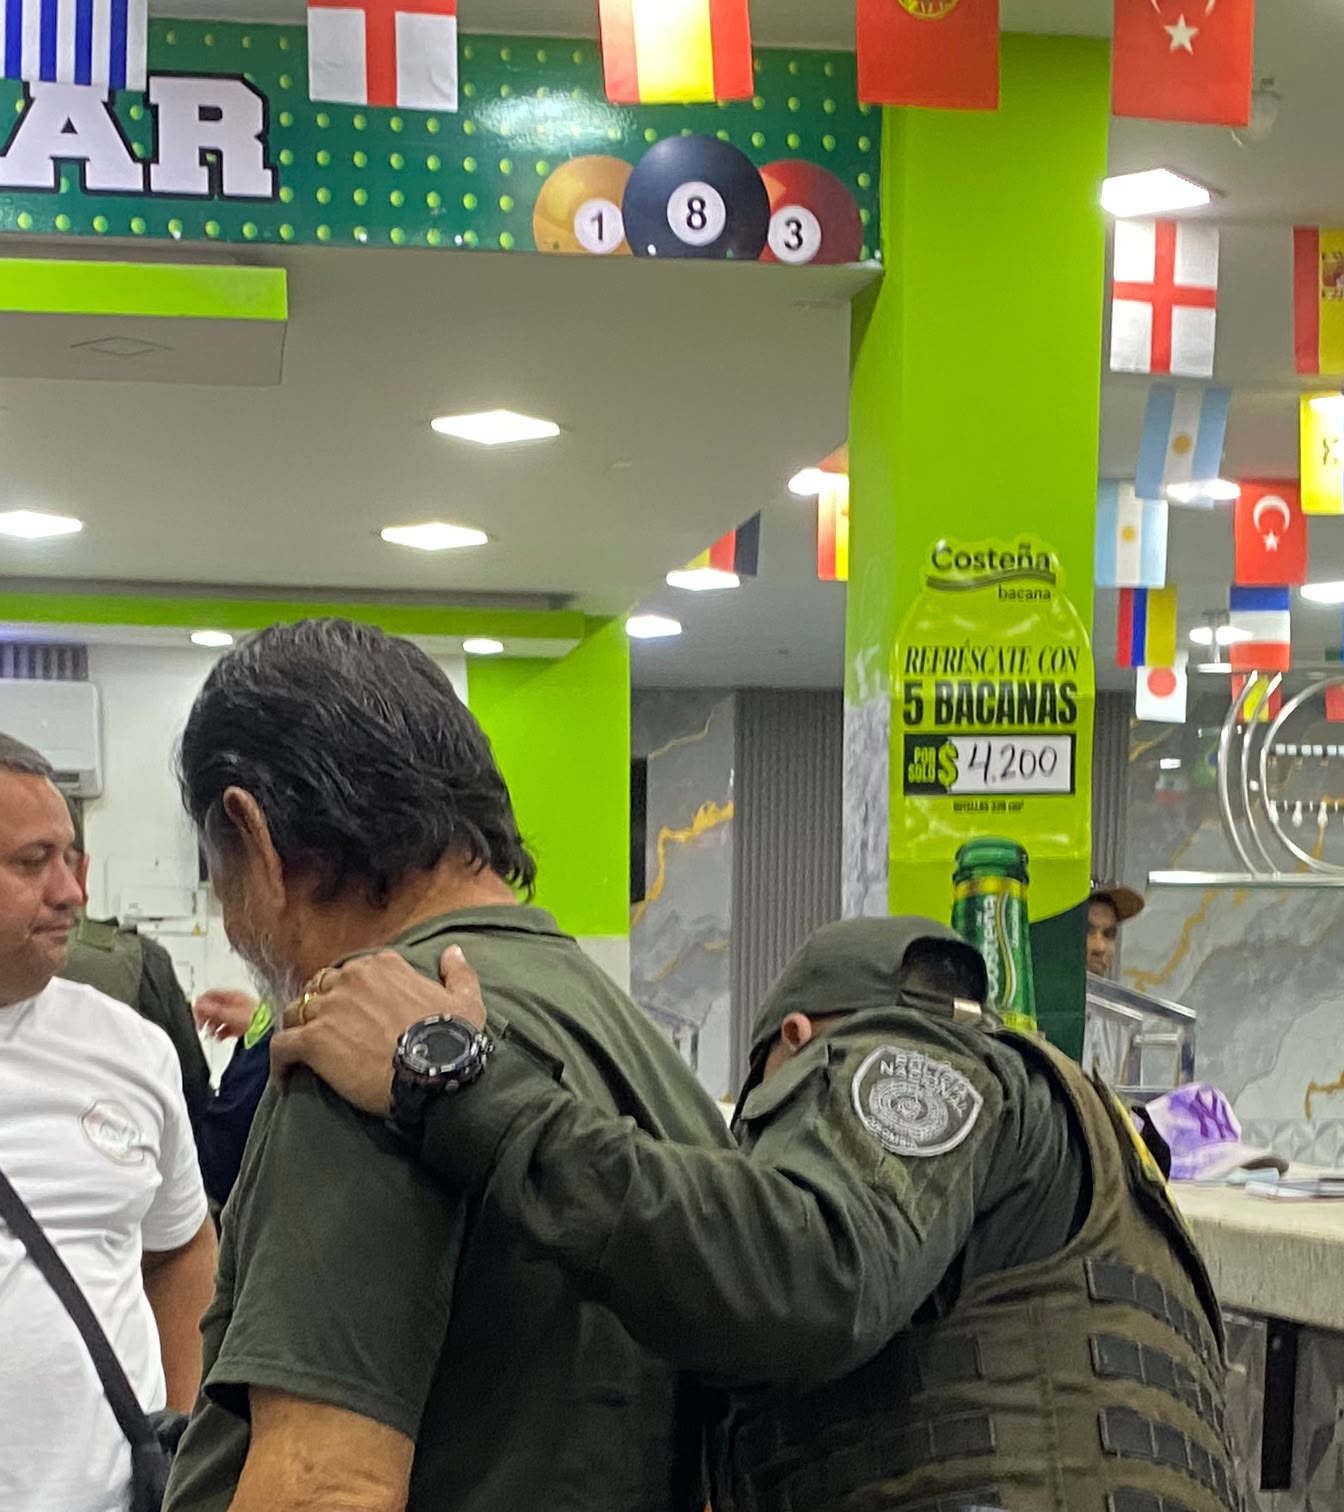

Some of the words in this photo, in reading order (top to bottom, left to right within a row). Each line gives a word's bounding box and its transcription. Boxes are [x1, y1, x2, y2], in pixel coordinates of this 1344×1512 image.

[590, 210, 604, 241] 1
[686, 195, 707, 230] 8
[784, 216, 804, 250] 3
[931, 542, 1051, 573] Costeña
[998, 584, 1052, 601] bacana
[1037, 645, 1080, 676] CON
[903, 680, 924, 726] 5
[934, 679, 1078, 726] BACANAS
